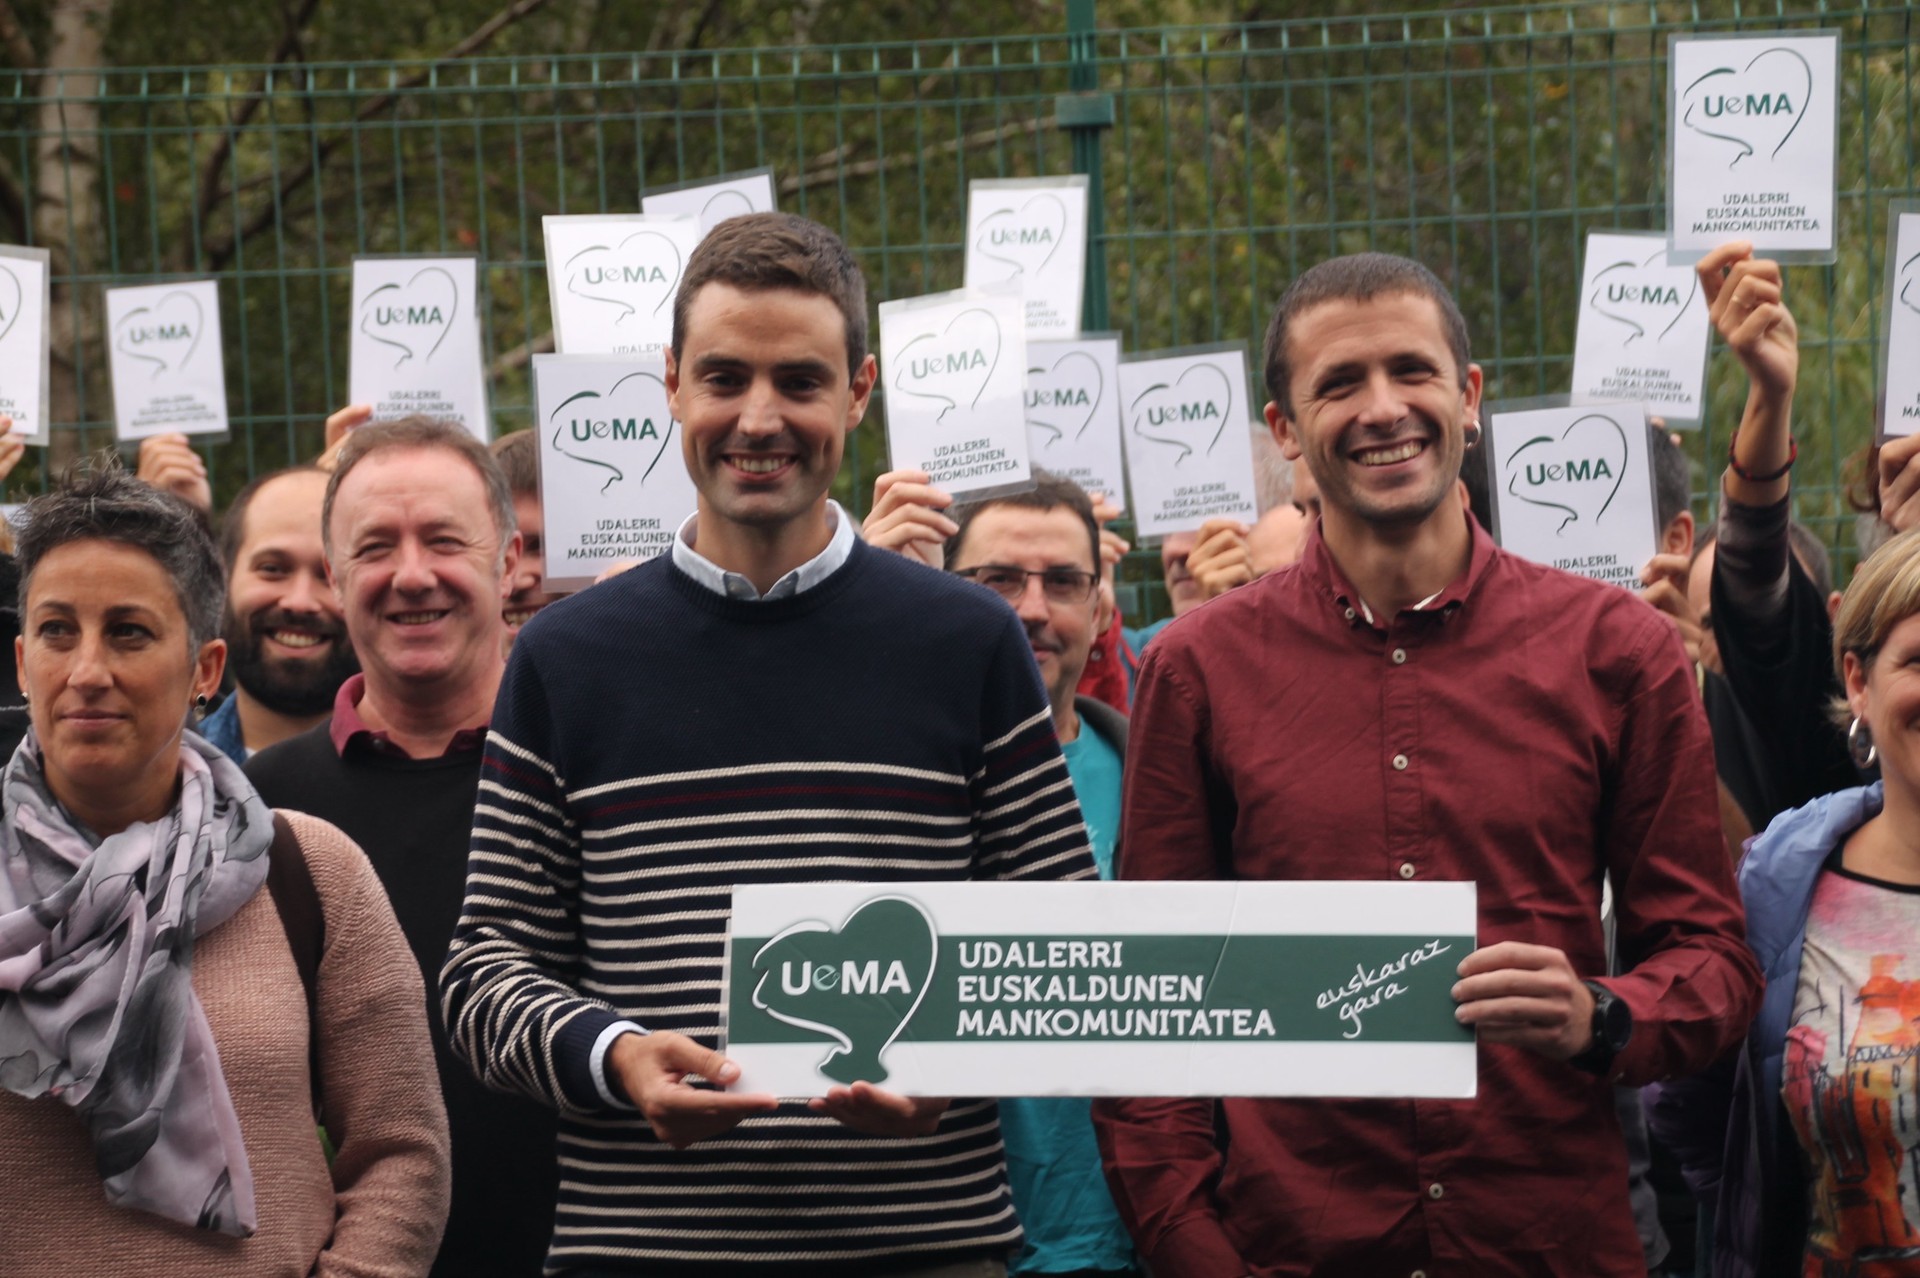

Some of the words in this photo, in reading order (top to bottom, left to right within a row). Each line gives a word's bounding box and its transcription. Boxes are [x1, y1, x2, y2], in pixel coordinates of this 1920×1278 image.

[1704, 93, 1793, 117] UeMA
[1723, 193, 1789, 205] UDALERRI
[1707, 206, 1806, 219] EUSKALDUNEN
[1692, 219, 1820, 233] MANKOMUNITATEA
[585, 266, 668, 284] UeMA
[1608, 284, 1679, 305] UeMA
[376, 306, 443, 325] UeMA
[911, 348, 987, 379] UeMA
[1148, 400, 1219, 426] UeMA
[571, 418, 659, 441] UeMA
[934, 438, 990, 457] UDALERRI
[921, 448, 1005, 472] EUSKALDUNEN
[927, 459, 1019, 484] NKOMUNITATEA
[1526, 458, 1613, 485] UeMA
[597, 519, 661, 531] UDALERRI
[1553, 554, 1617, 569] UDALERRI
[958, 941, 1123, 968] UDALERRI
[781, 960, 912, 996] UeMA
[1316, 939, 1451, 1009] euskaraz
[957, 975, 1204, 1003] EUSKALDUNEN
[956, 1009, 1276, 1036] MANKOMUNITATEA
[1339, 982, 1409, 1039] gara
